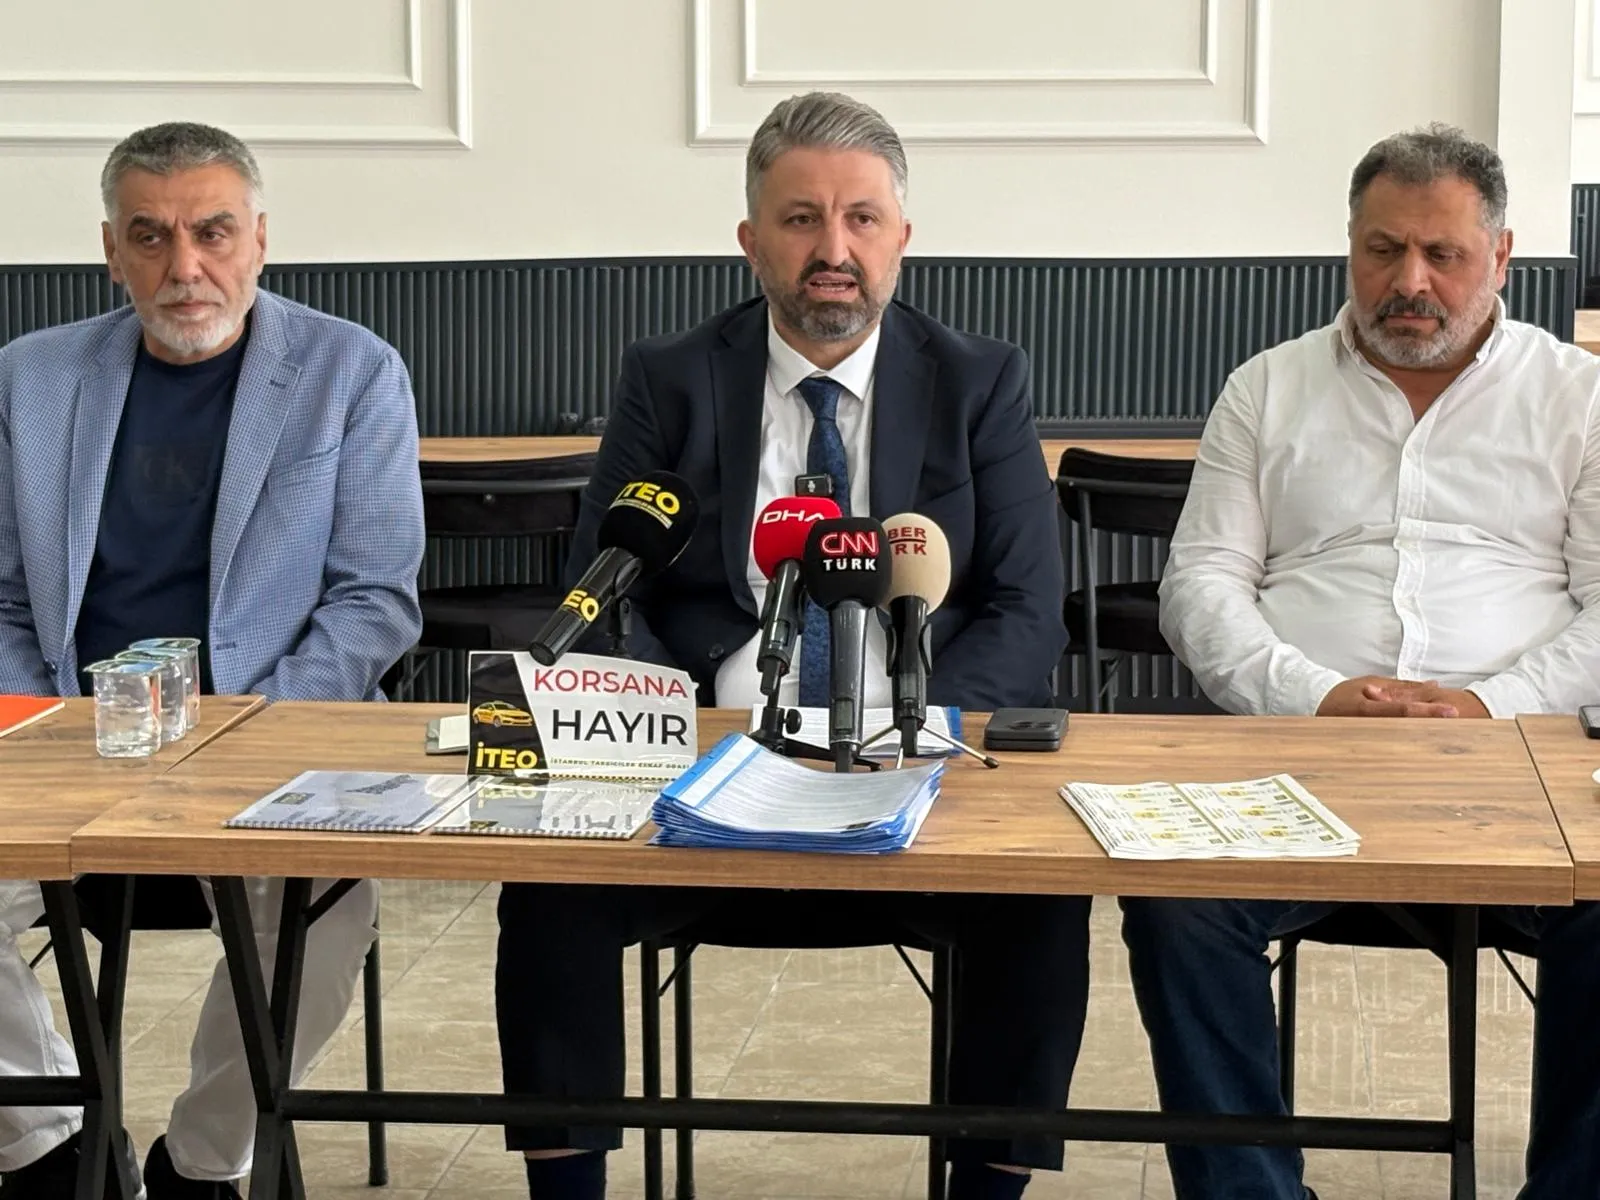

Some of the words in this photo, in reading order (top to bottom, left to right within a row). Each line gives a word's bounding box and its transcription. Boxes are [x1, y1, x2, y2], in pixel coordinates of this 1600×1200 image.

[762, 509, 825, 524] DHA
[821, 531, 878, 557] CNN
[823, 557, 877, 572] TÜRK
[534, 669, 688, 698] KORSANA
[552, 709, 688, 746] HAYIR
[476, 741, 538, 769] İTEO
